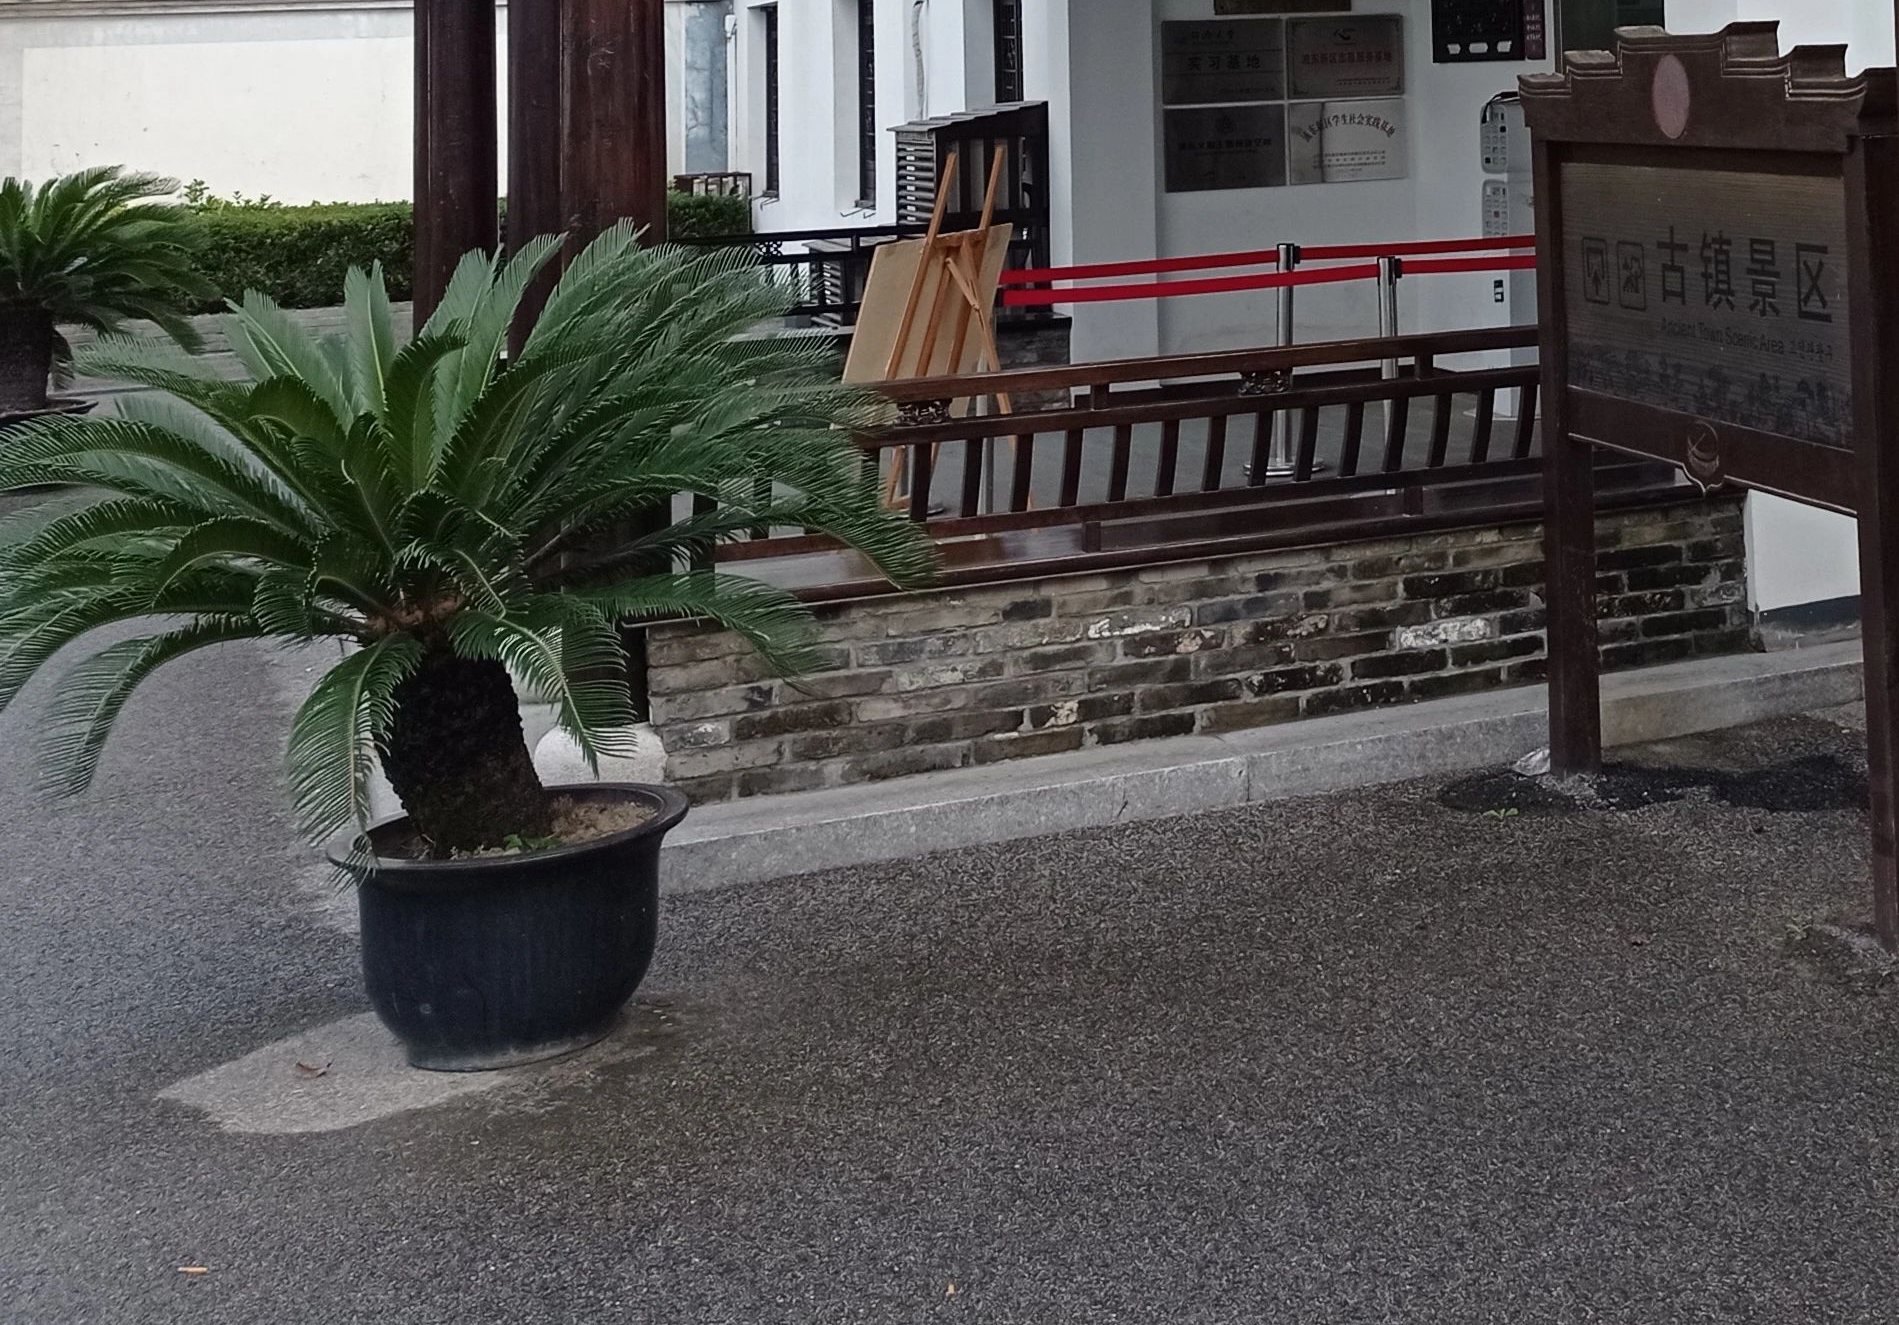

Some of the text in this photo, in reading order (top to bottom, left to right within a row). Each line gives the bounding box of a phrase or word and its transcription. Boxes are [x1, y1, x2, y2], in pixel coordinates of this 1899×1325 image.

[1187, 54, 1261, 71] 实习基地
[1655, 224, 1834, 324] 古镇景区
[1661, 317, 1696, 338] Ancient
[1698, 322, 1724, 344] Town
[1760, 334, 1785, 355] Area
